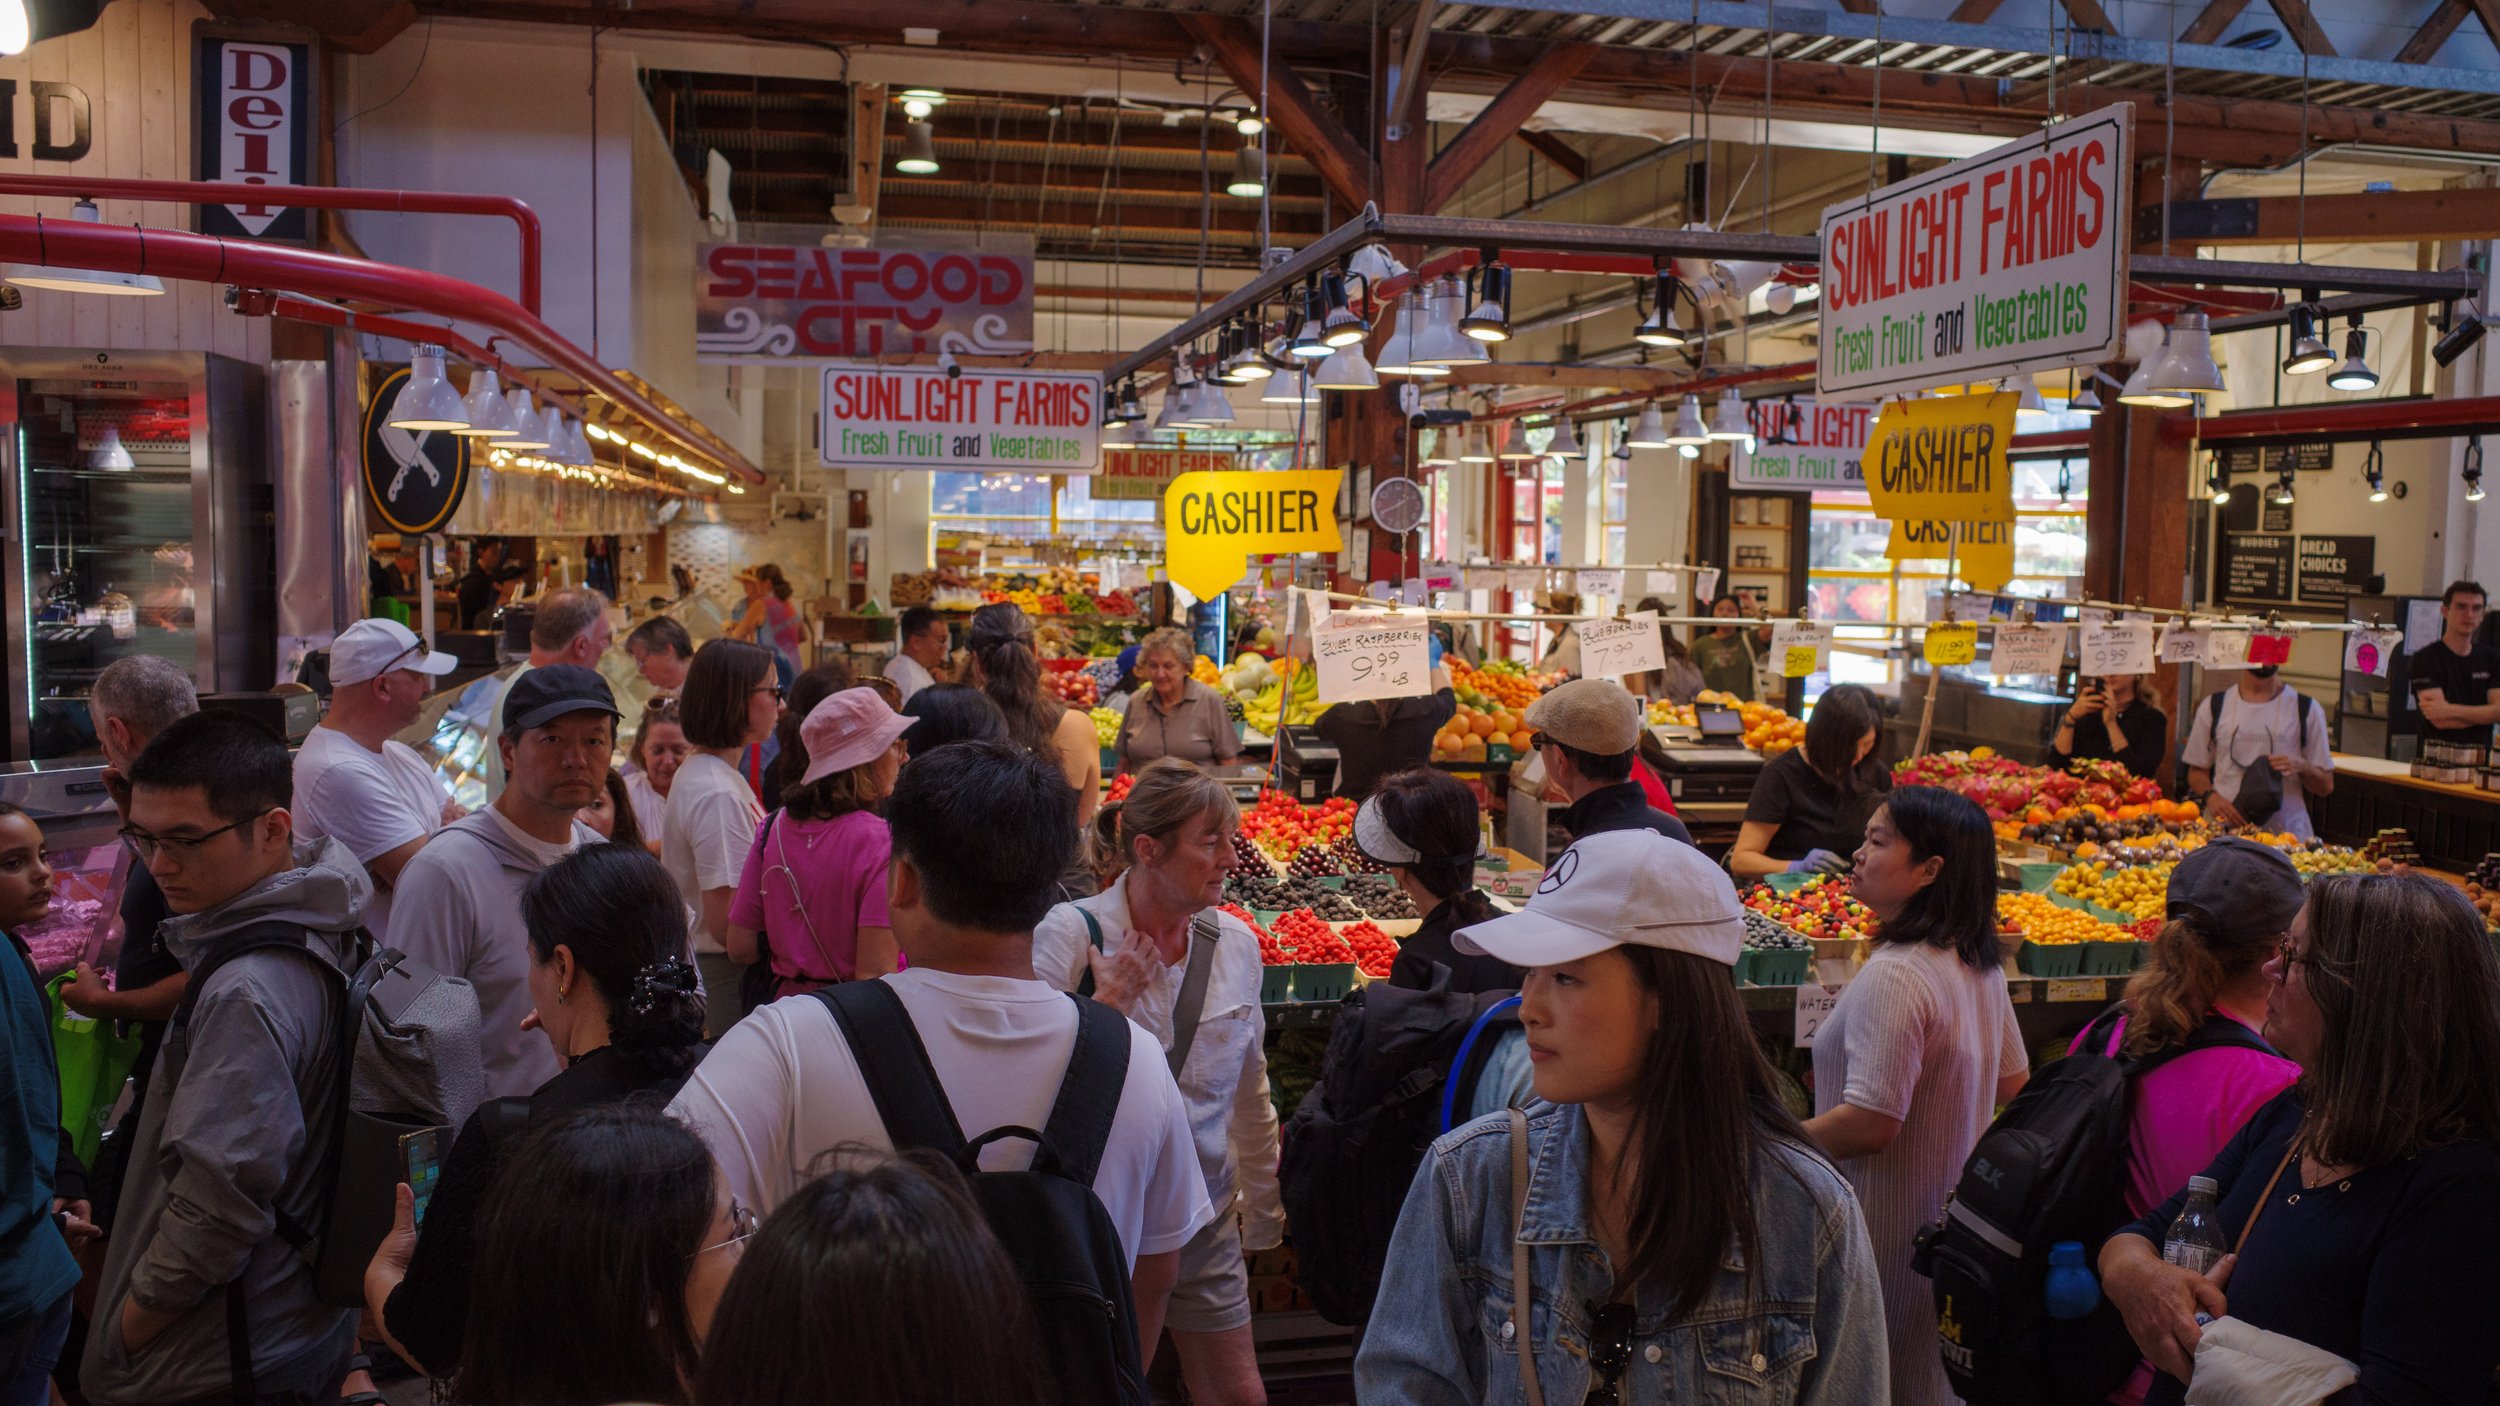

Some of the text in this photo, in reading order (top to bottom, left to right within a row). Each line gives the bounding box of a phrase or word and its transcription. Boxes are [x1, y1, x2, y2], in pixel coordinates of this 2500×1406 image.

[1829, 139, 2105, 311] SUNLIGHT FARMS
[708, 246, 1023, 306] SEAFOOD
[795, 305, 943, 355] CITY
[1834, 282, 2088, 376] Fresh Fruit and Vegetables
[833, 375, 1091, 427] SUNLIGHT FARMS
[842, 428, 1081, 461] Fresh Fruit and Vegetables
[1751, 454, 1790, 479] Fresh
[1797, 454, 1835, 480] Fruit
[1881, 423, 1995, 494] CASHIER
[1180, 490, 1319, 535] CASHIER
[2301, 540, 2336, 556] BREAD
[2301, 556, 2347, 573] CHOICES
[1972, 1157, 2005, 1190] BLK
